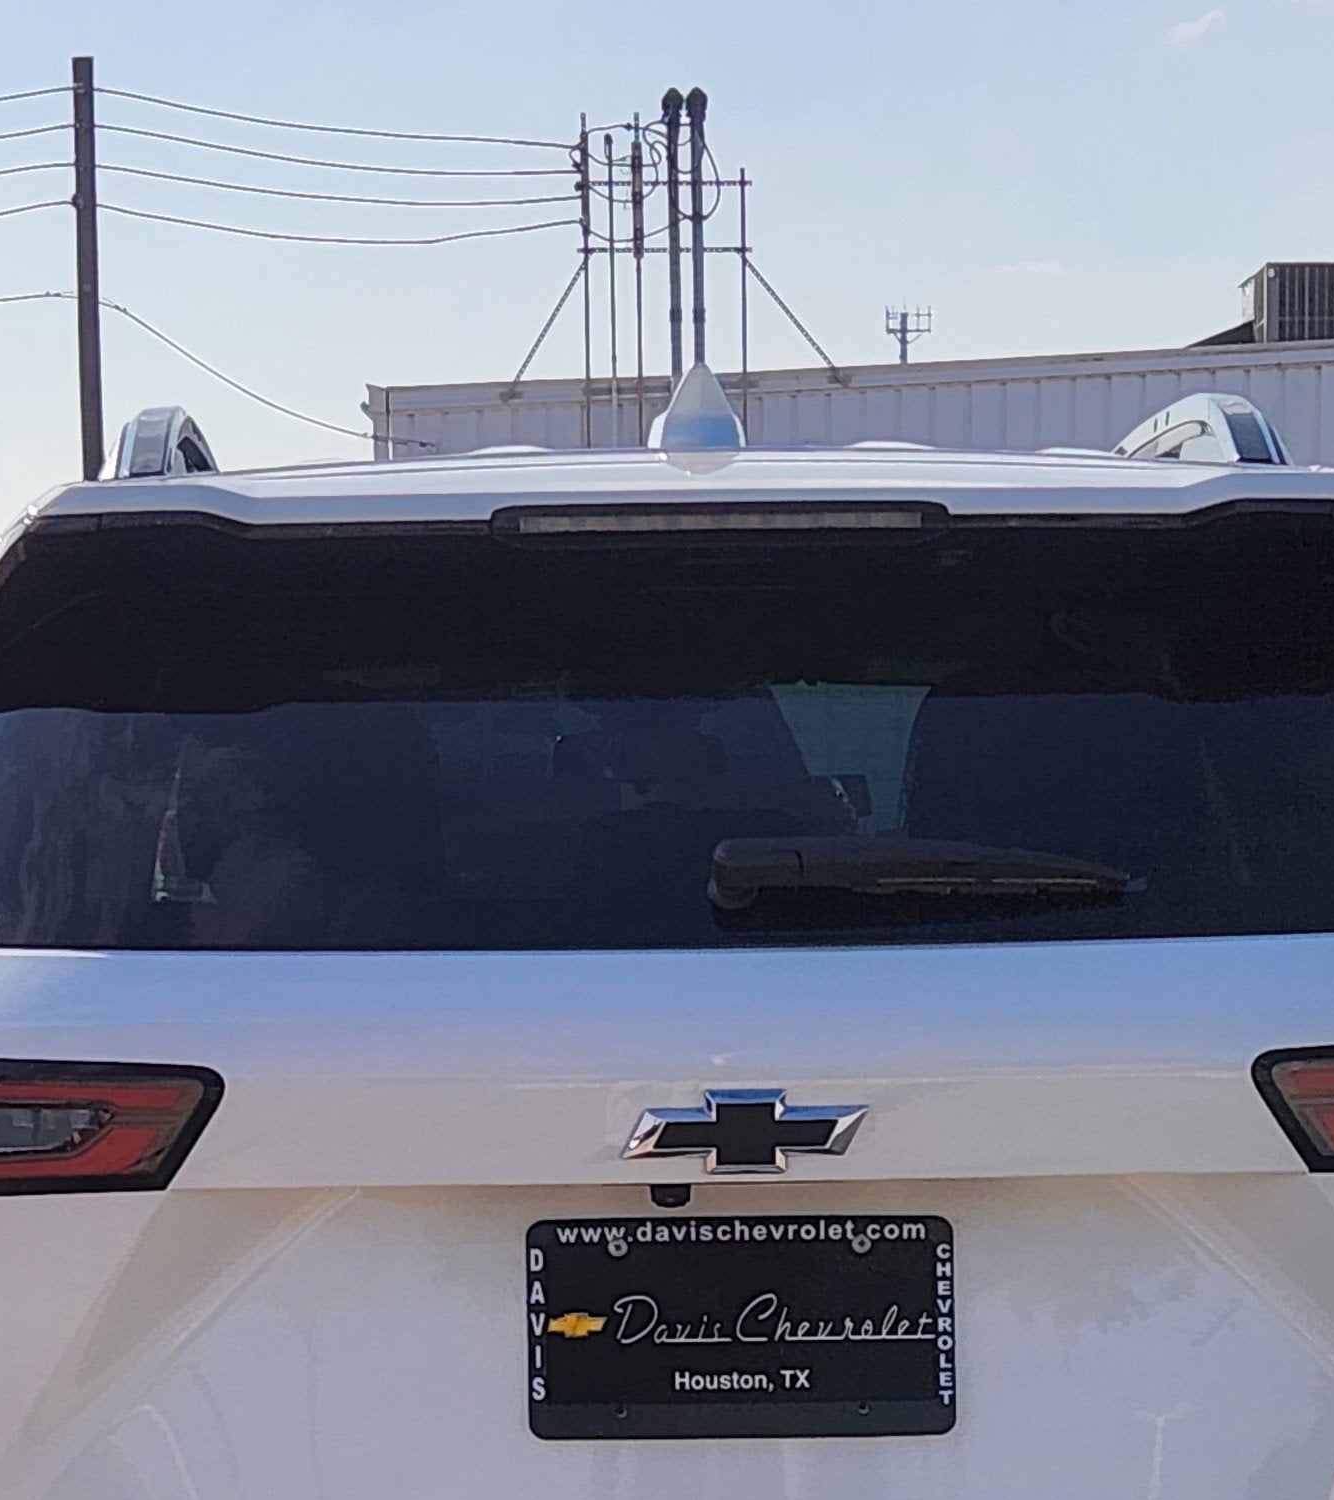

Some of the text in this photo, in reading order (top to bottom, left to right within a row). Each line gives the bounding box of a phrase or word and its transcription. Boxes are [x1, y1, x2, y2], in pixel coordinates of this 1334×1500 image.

[556, 1219, 927, 1243] www.davischevroletcom
[529, 1247, 546, 1401] DAVIS
[613, 1293, 936, 1344] Davis Chevrolet
[935, 1243, 954, 1405] CHEVROLET
[674, 1369, 811, 1392] Houston, TX
